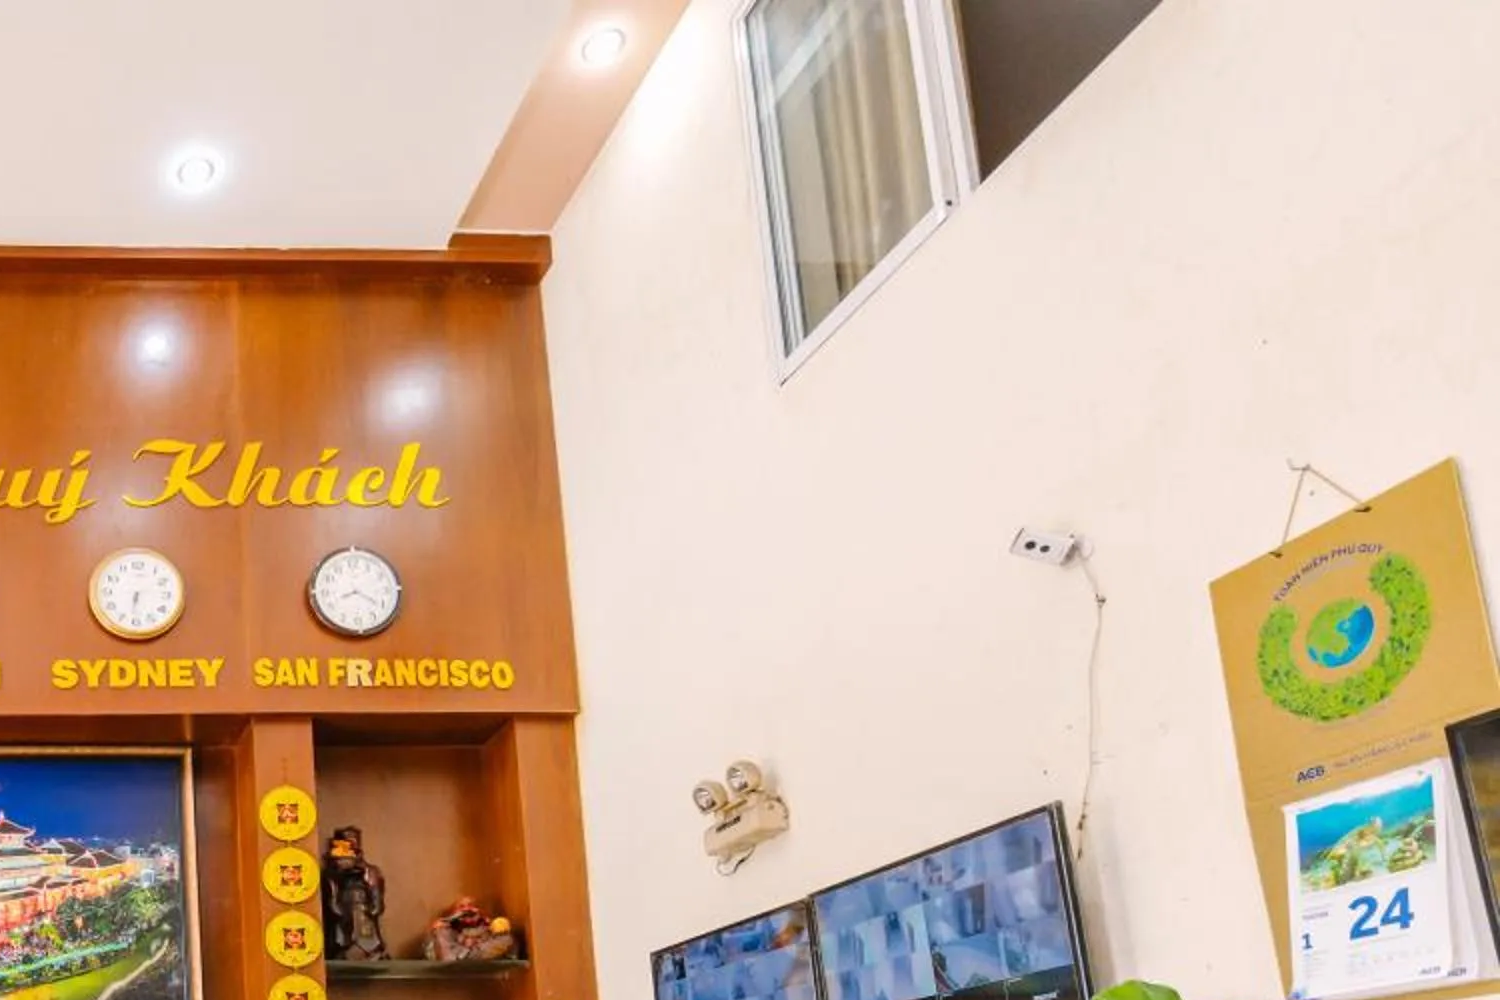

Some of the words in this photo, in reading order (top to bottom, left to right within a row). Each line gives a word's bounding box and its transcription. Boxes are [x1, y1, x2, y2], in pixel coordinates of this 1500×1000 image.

[122, 438, 450, 509] Khách
[51, 658, 225, 689] SYDNEY
[254, 657, 320, 687] SAN
[327, 657, 514, 689] FRANCISCO
[1348, 887, 1414, 941] 24
